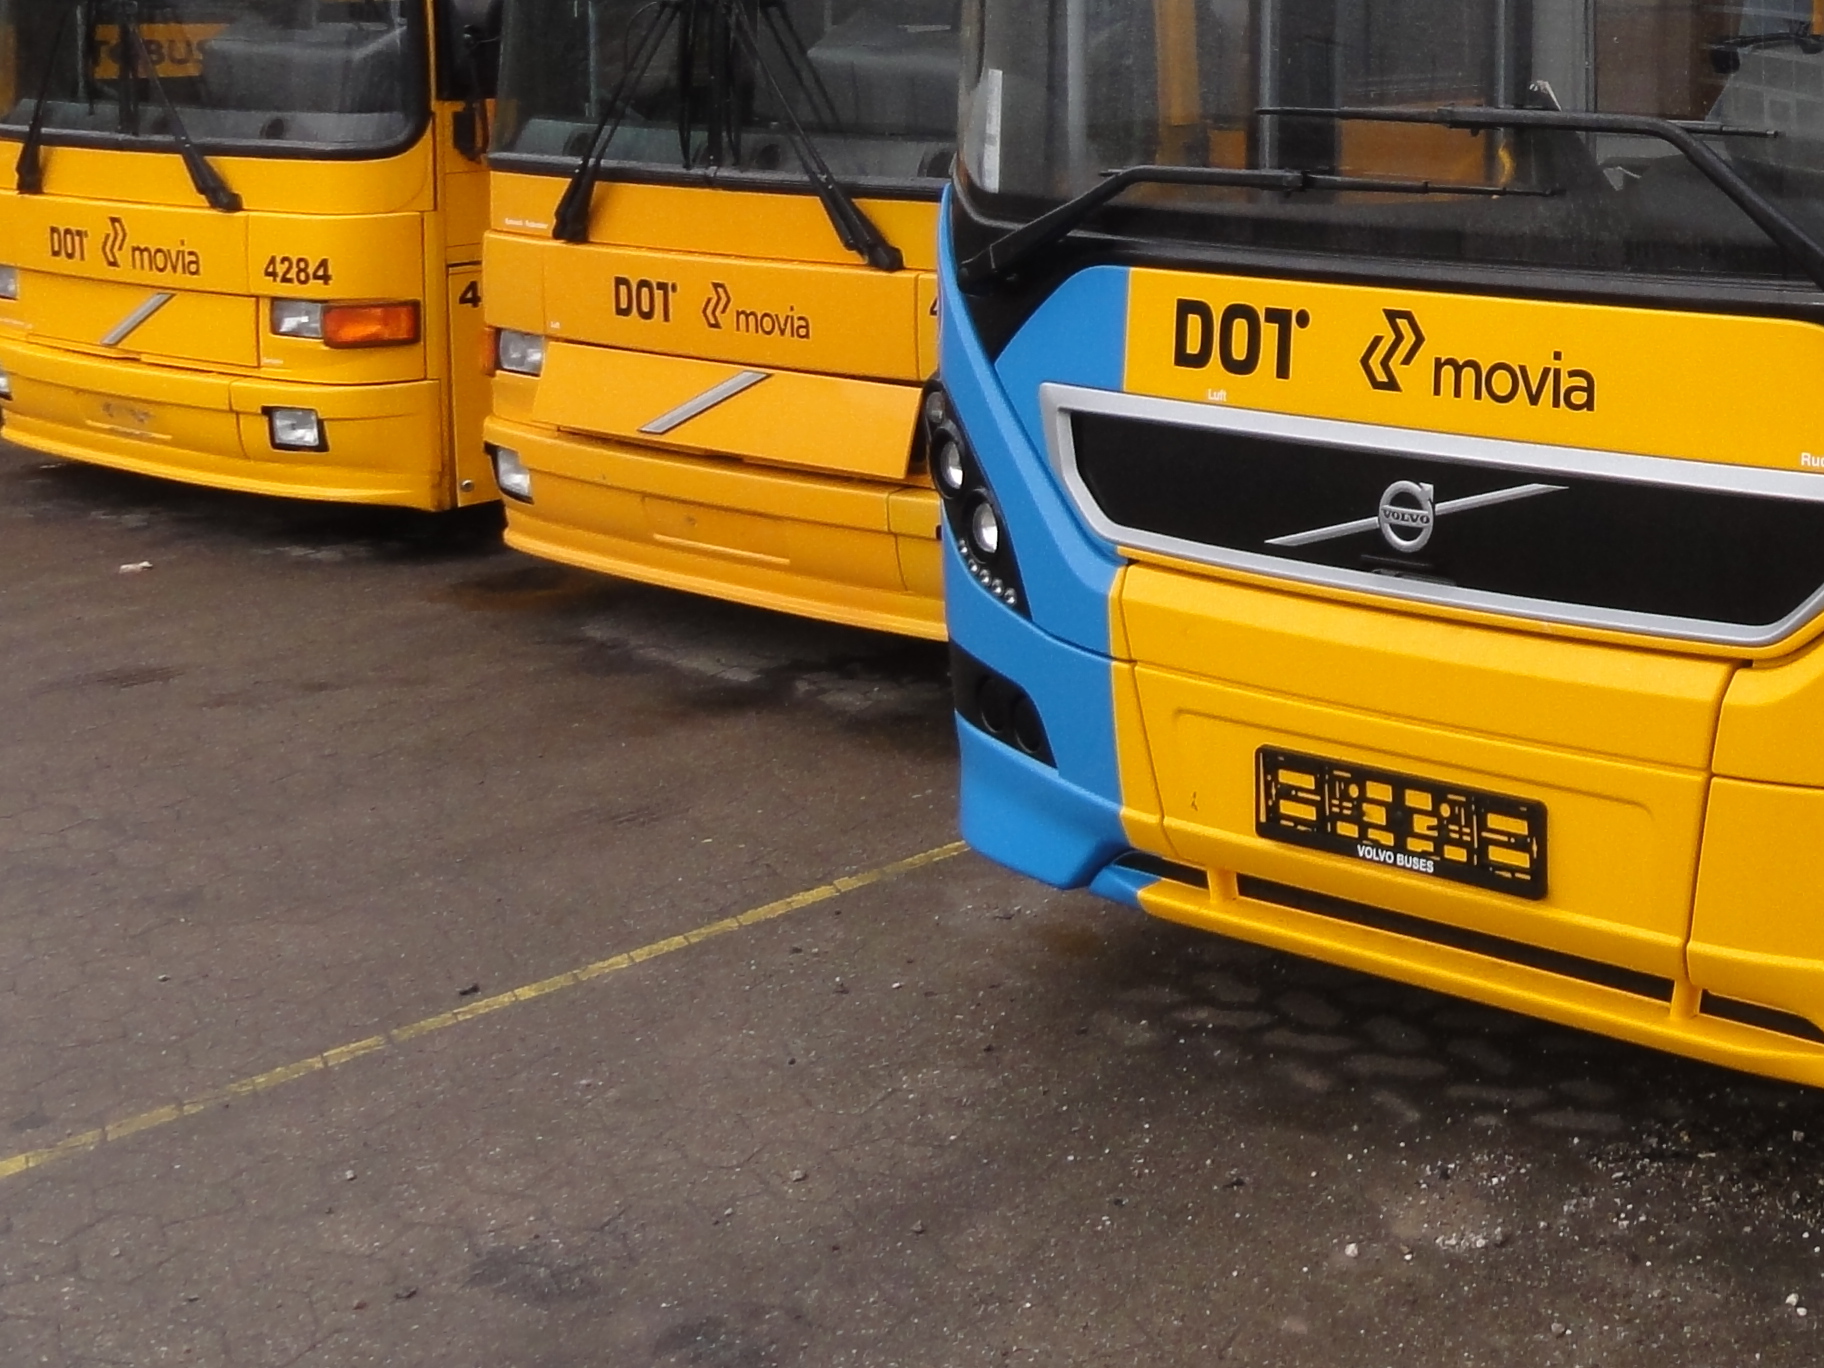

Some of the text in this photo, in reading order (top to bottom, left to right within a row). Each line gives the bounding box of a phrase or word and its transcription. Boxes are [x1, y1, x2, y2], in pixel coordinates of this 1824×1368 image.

[50, 226, 88, 261] DOT
[131, 240, 201, 276] movia
[264, 255, 332, 285] 4284
[614, 276, 678, 322] DOT
[735, 306, 811, 339] movia
[1174, 298, 1310, 379] DOT
[1207, 388, 1228, 402] Luft
[1432, 351, 1596, 412] movia
[1382, 509, 1431, 525] VOLVO
[1357, 843, 1434, 874] VOLVO BUSES
